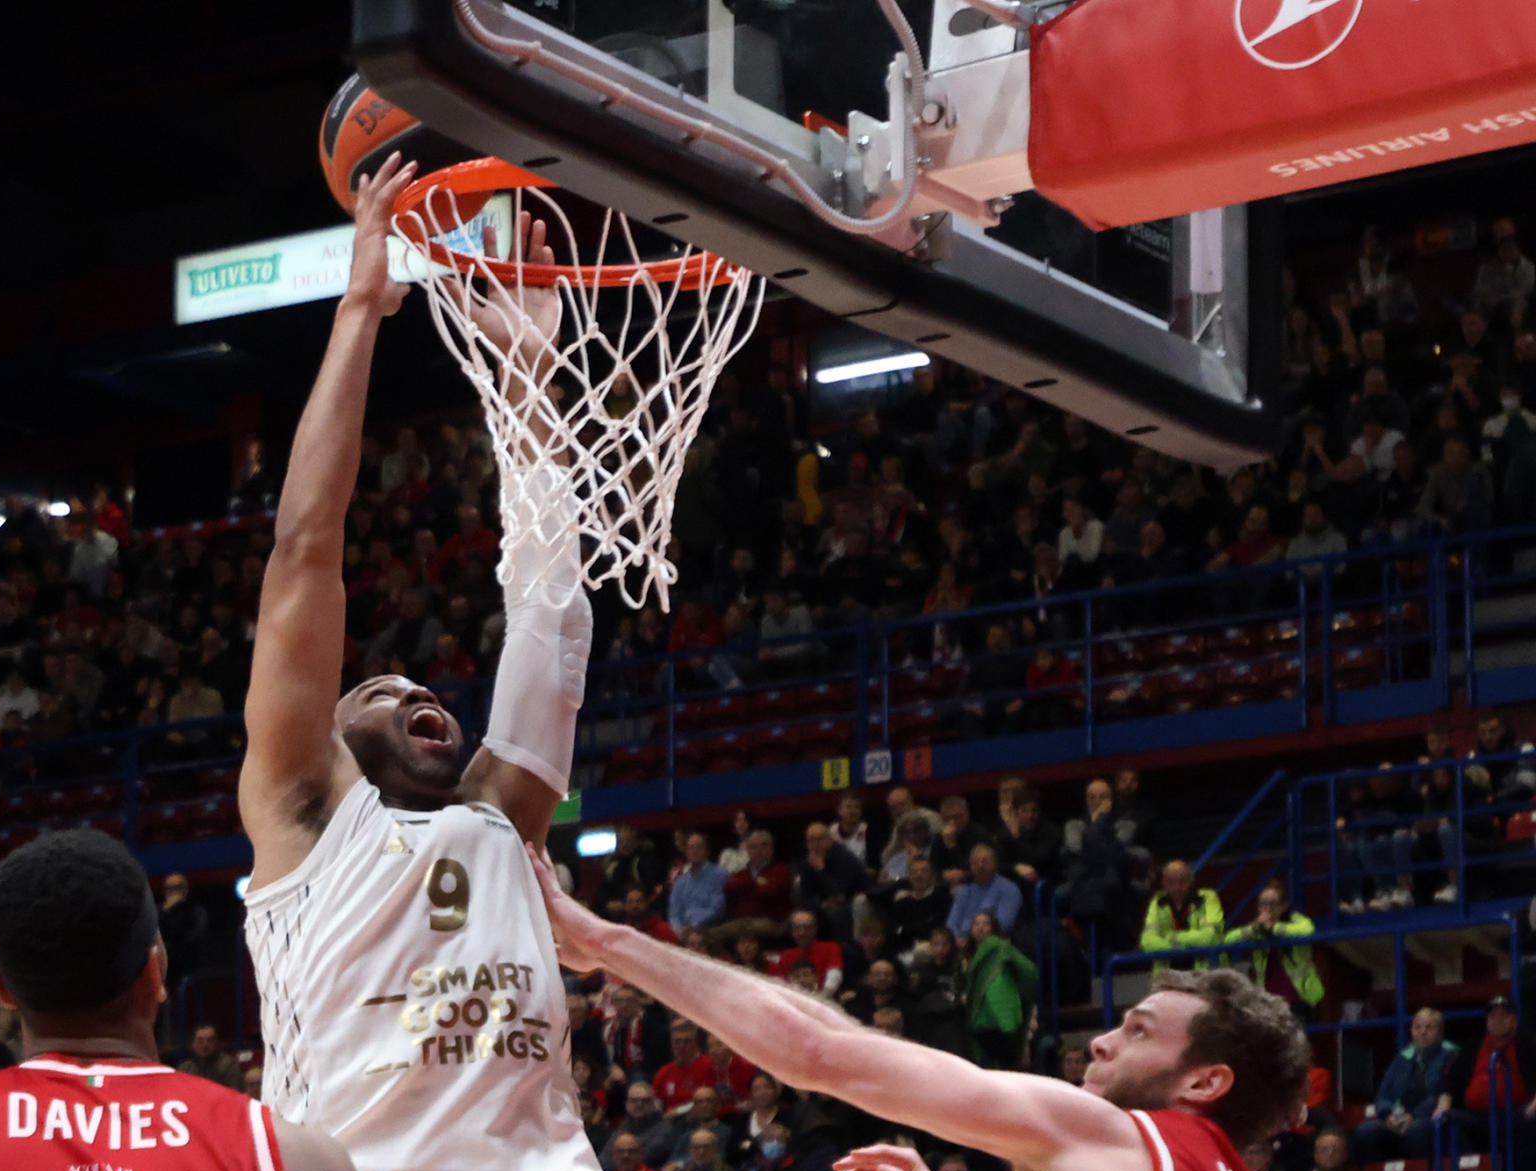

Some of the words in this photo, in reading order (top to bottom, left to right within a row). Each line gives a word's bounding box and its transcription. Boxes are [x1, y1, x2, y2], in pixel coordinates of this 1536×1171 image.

[1462, 107, 1536, 135] ISH
[1269, 127, 1451, 177] AIRLINES
[194, 259, 274, 294] ULIVETO
[425, 858, 470, 932] 9
[410, 962, 534, 997] SMART
[401, 997, 518, 1034] GOOD
[412, 1030, 549, 1065] THINGS
[8, 1091, 190, 1150] DAVIES
